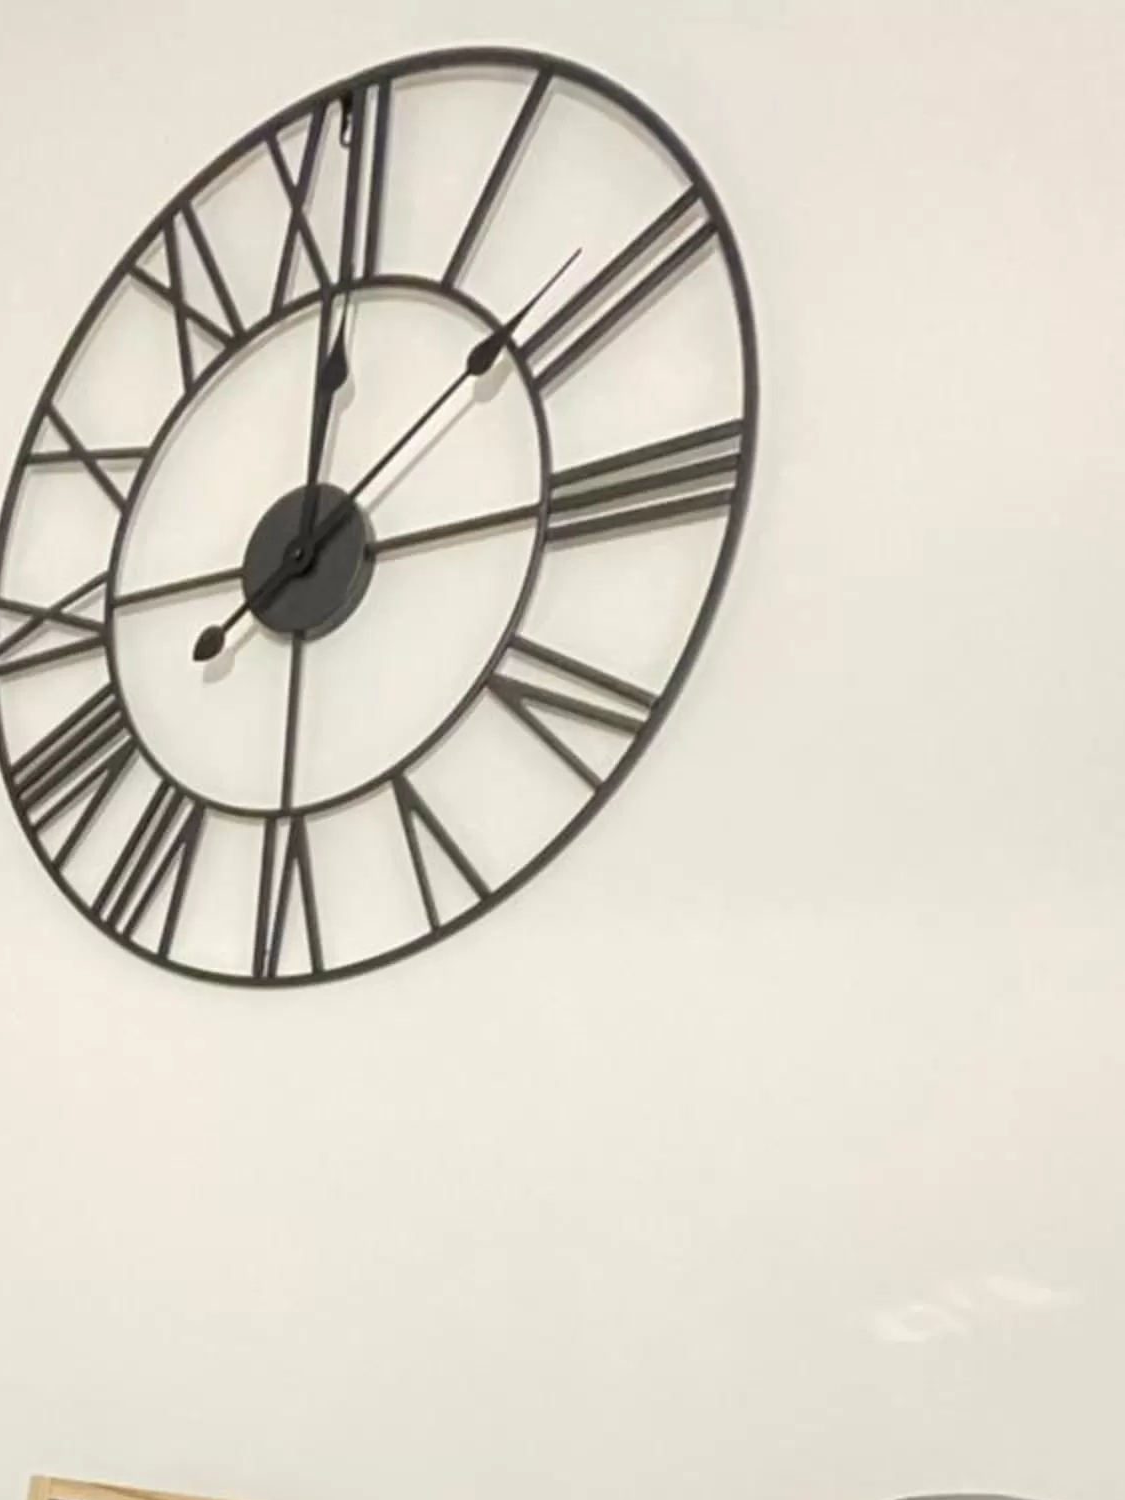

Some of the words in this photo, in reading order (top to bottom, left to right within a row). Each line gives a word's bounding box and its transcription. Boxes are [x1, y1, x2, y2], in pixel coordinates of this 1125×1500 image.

[265, 78, 393, 316] XII
[515, 180, 721, 392] II
[123, 200, 249, 398] XI
[21, 402, 153, 514] X
[545, 416, 745, 542] III
[9, 682, 137, 872] VIII
[483, 632, 665, 794] IV
[91, 778, 205, 962] VII
[389, 772, 493, 932] V
